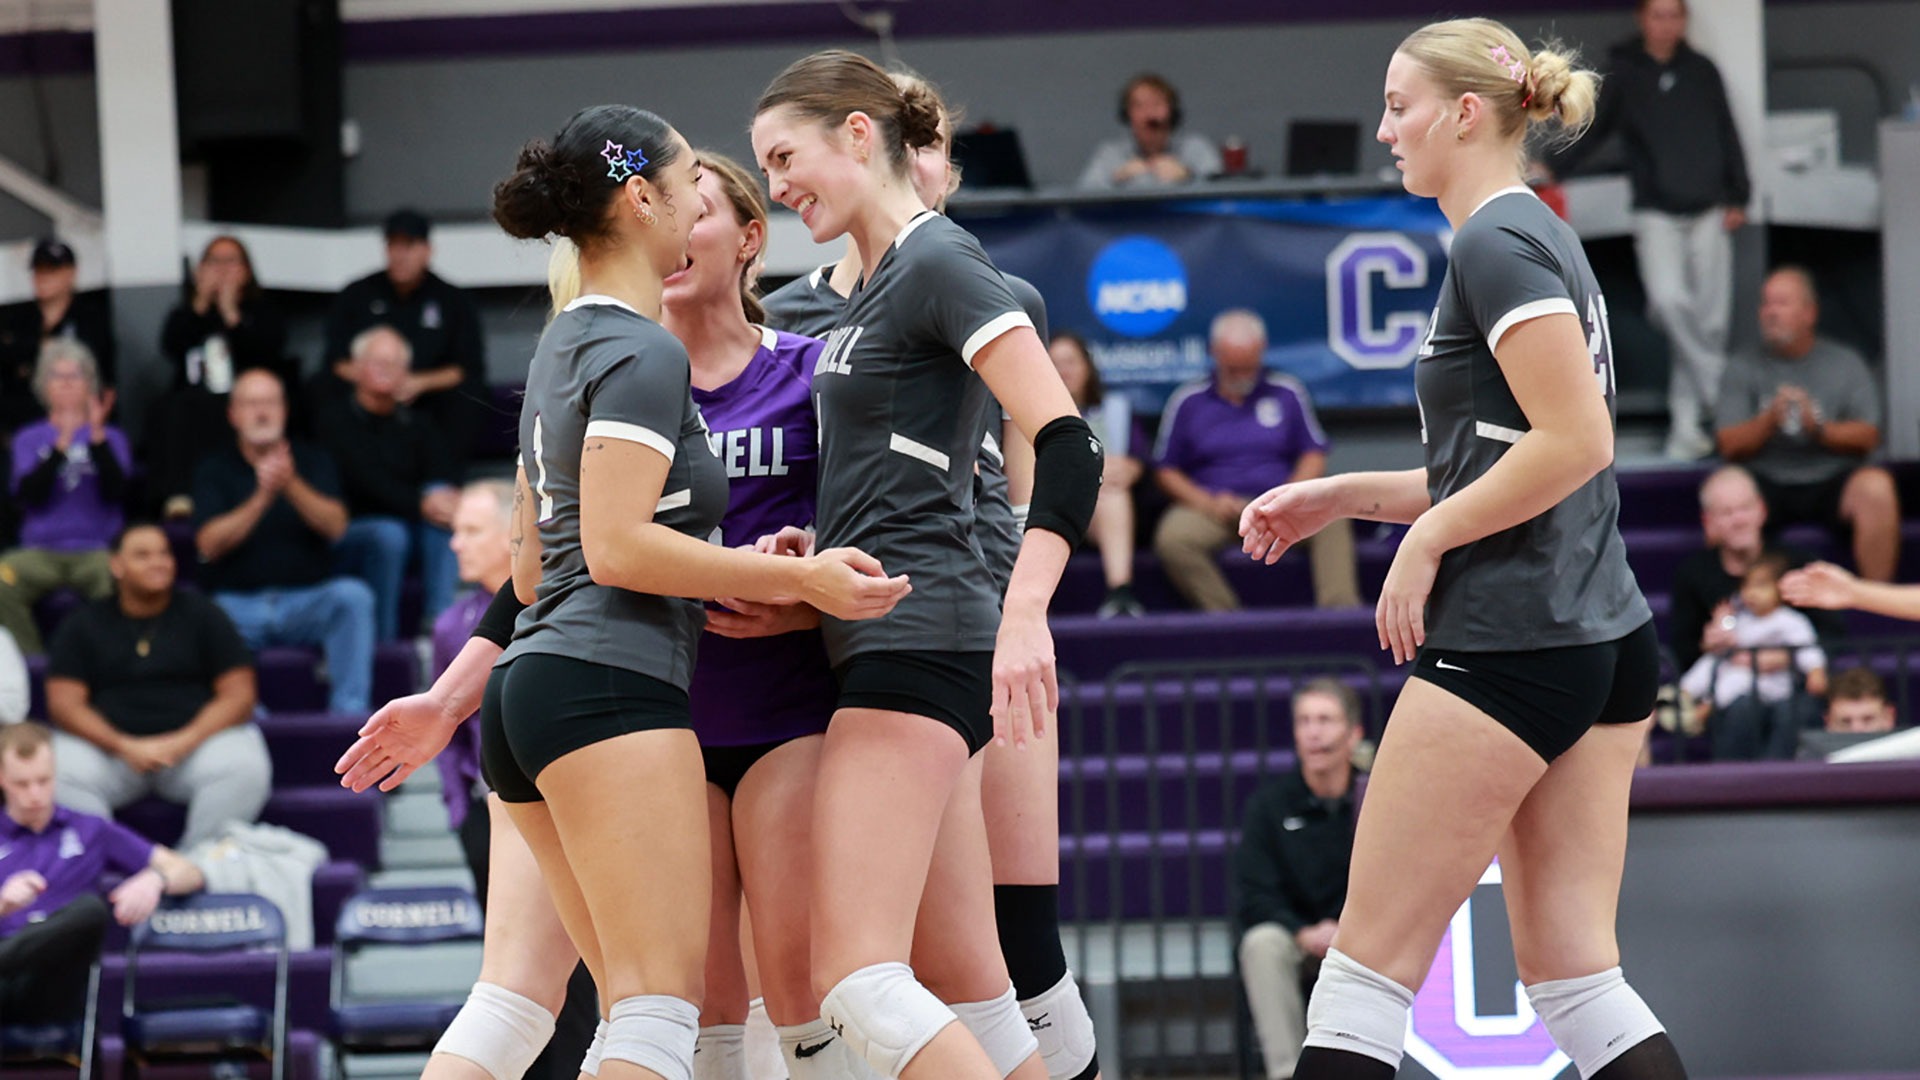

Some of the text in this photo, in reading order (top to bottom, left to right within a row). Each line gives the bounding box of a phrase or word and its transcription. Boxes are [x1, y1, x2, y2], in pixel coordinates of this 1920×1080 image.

[1098, 279, 1187, 315] NCAA
[1325, 231, 1428, 370] C
[151, 905, 266, 934] CORNELL
[355, 899, 470, 928] CORNELL
